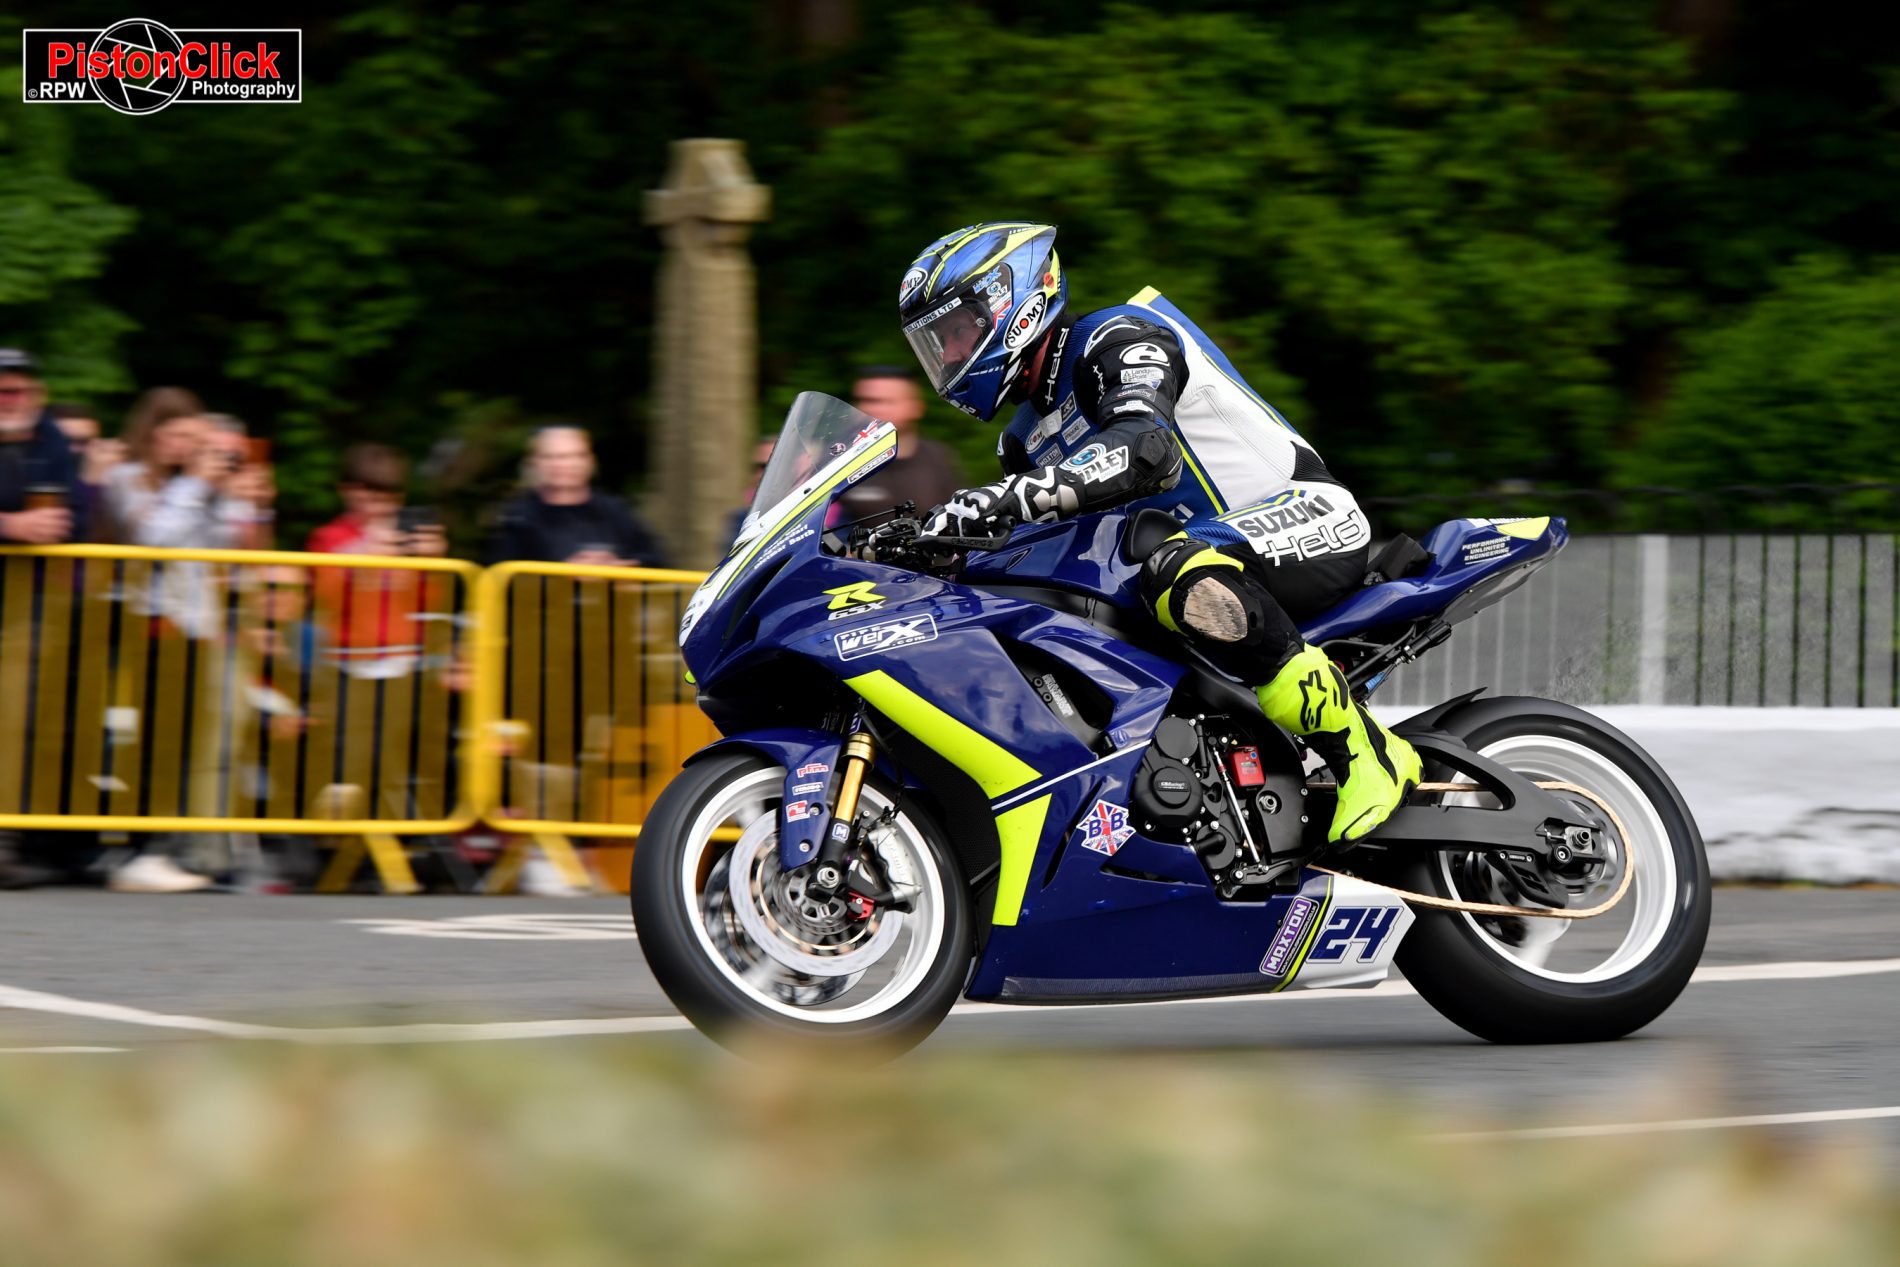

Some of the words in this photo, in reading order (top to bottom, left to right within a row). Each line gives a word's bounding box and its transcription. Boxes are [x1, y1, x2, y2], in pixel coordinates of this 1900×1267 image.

[938, 302, 954, 316] LTD
[1006, 298, 1046, 344] SUOMY
[1044, 327, 1070, 405] Held
[1237, 494, 1335, 538] SUZUKI
[1264, 509, 1366, 567] Held
[1461, 536, 1511, 550] PERFORMANCE
[1464, 547, 1510, 561] ENGINEERING
[1469, 543, 1505, 555] UNLIMITED
[828, 600, 886, 621] GSX
[1266, 903, 1308, 971] MAXTON
[1307, 906, 1403, 963] 24
